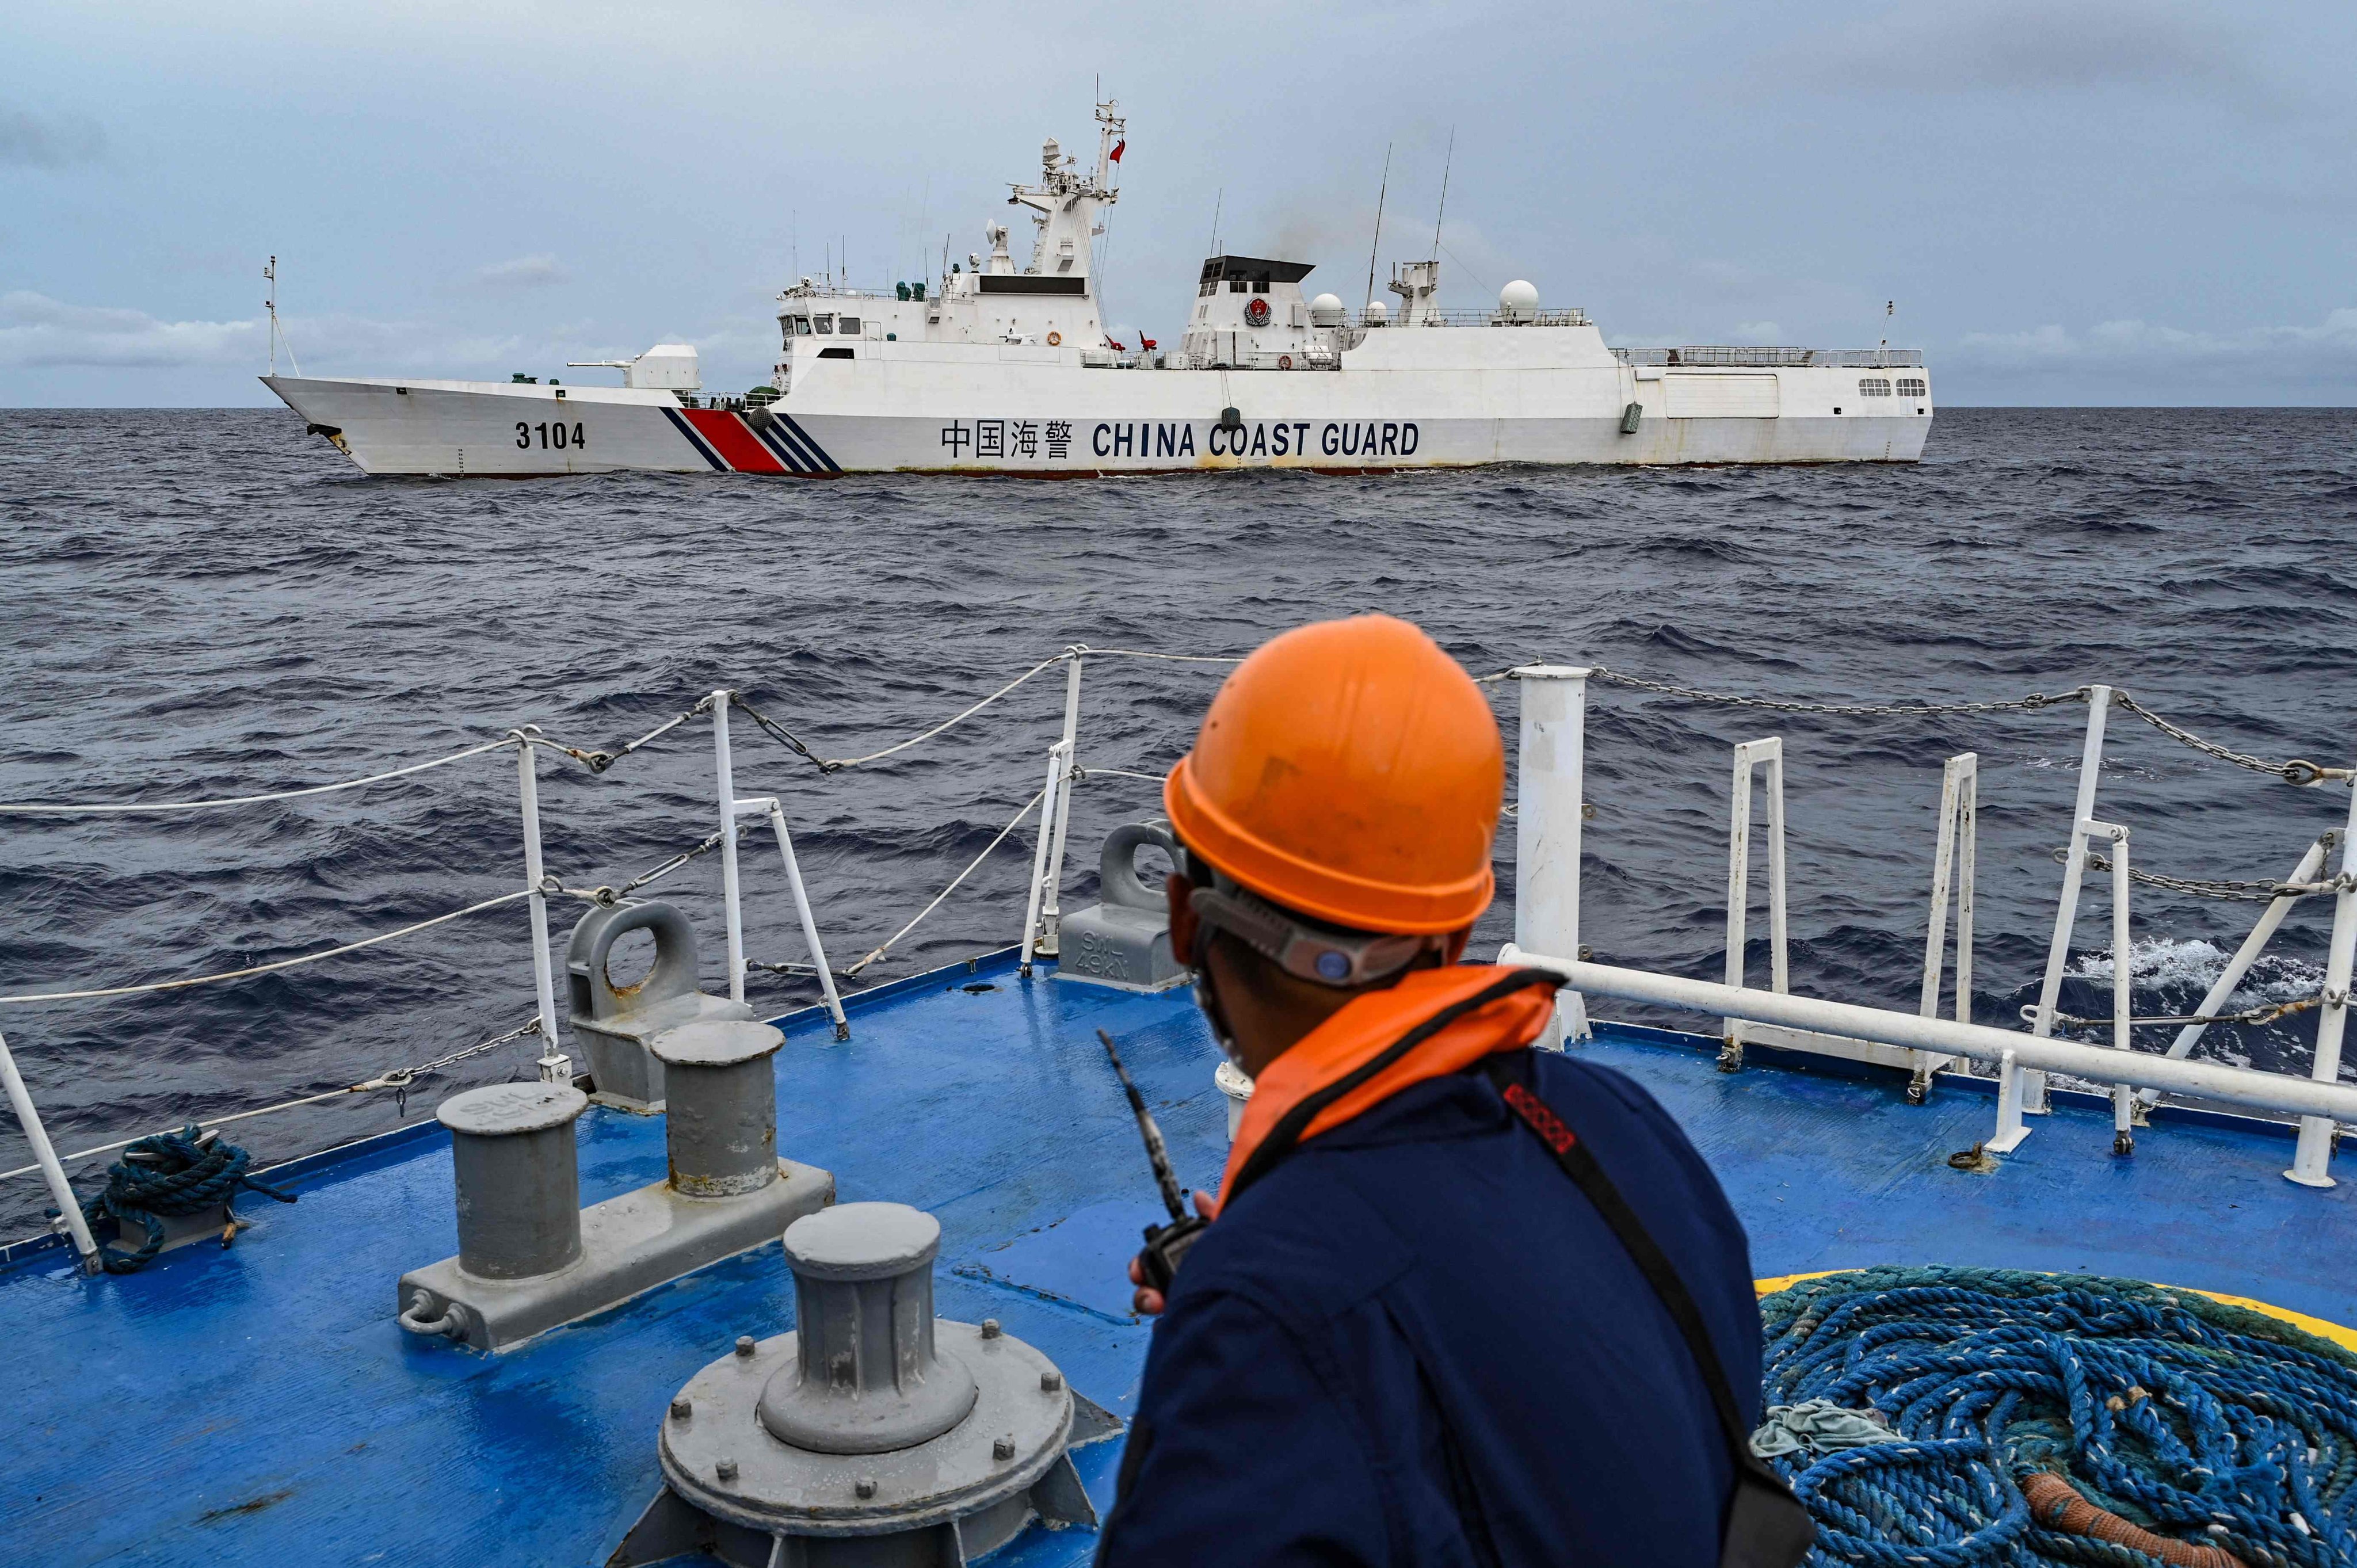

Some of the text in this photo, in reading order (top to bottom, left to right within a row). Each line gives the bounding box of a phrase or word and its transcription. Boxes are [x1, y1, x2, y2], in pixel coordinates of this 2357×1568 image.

[516, 422, 586, 449] 3104
[941, 419, 1073, 460] 中国海警
[1093, 423, 1419, 457] CHINA COAST GUARD
[1082, 930, 1123, 957] SWL
